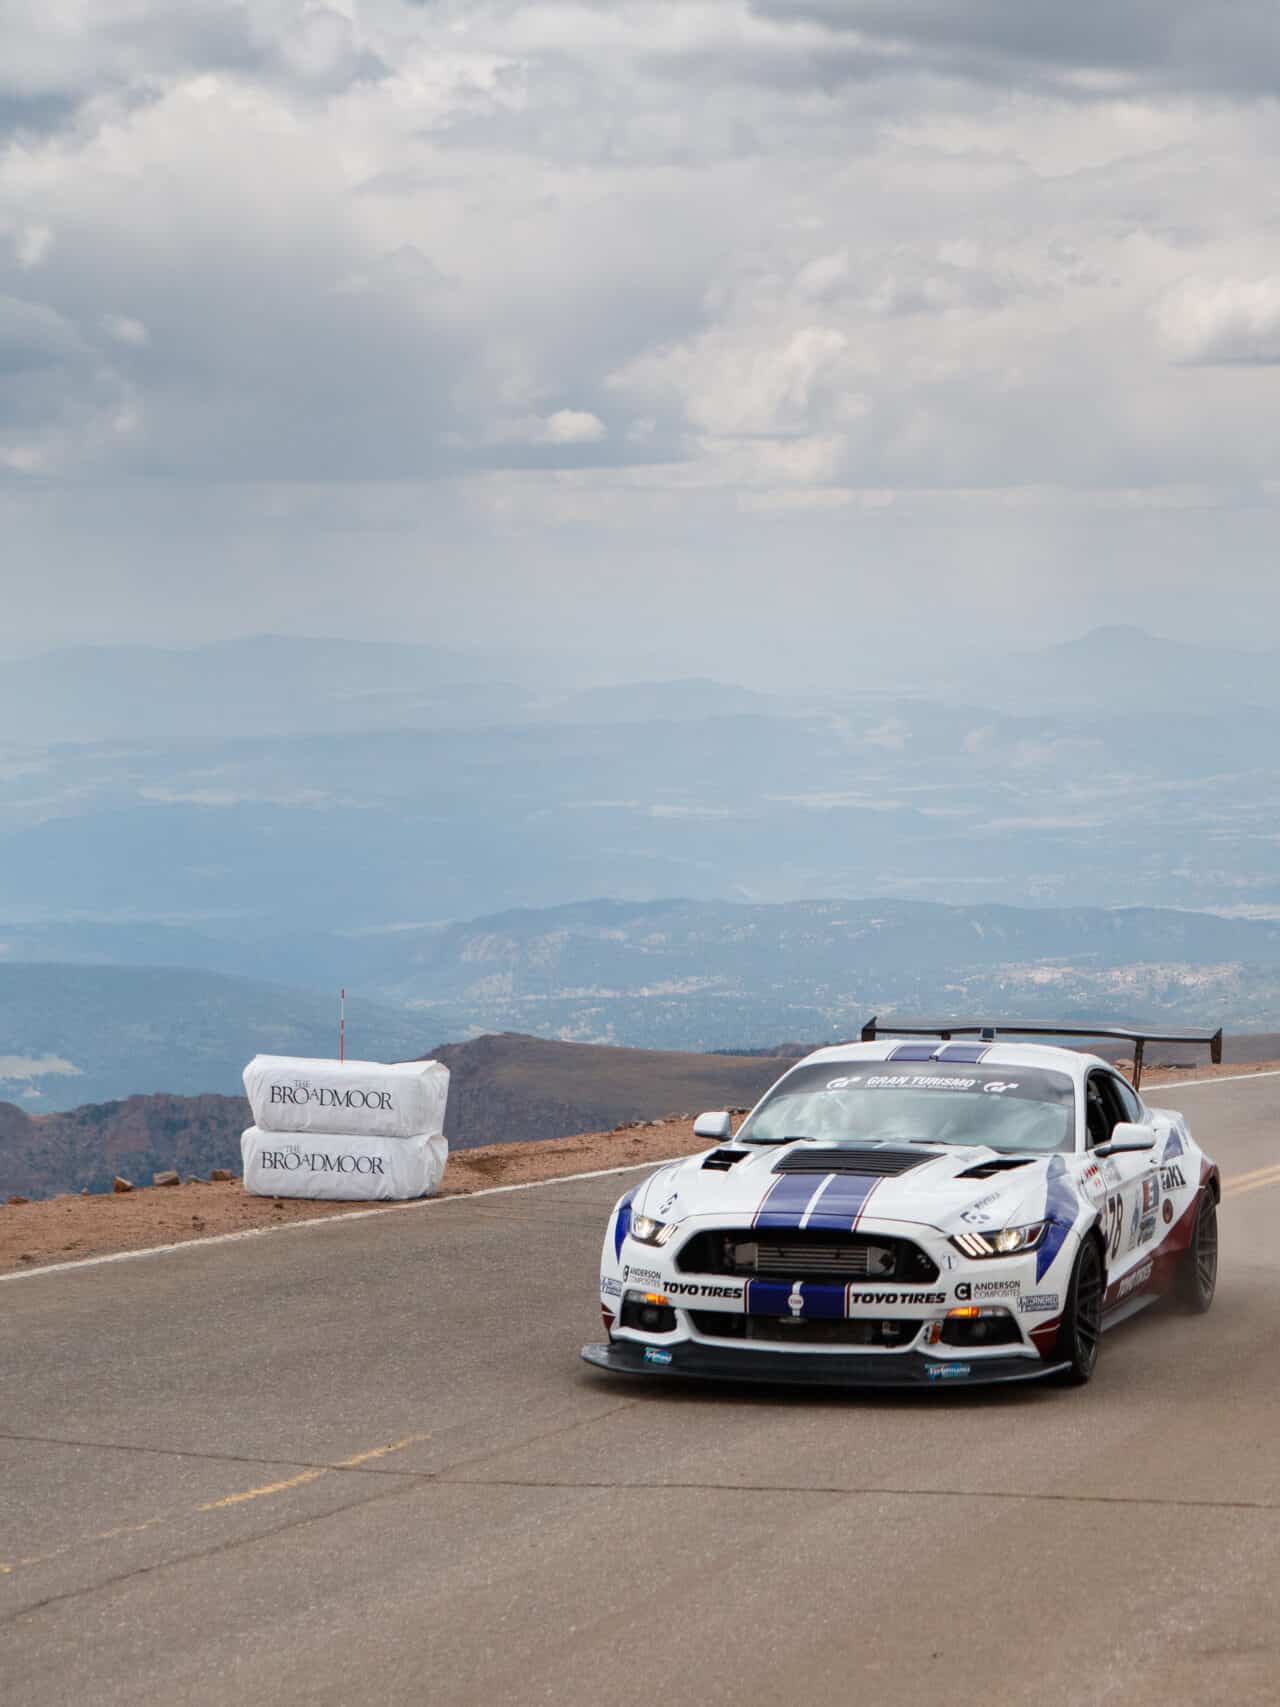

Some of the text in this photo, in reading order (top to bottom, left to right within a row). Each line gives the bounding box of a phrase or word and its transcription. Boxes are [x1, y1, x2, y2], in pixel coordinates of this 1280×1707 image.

[867, 1076, 910, 1086] GRAN
[911, 1076, 976, 1088] TURISMO
[270, 1086, 393, 1110] BROADMOOR
[262, 1151, 384, 1175] BROADMOOR
[630, 1267, 662, 1280] ANDERSON
[663, 1281, 743, 1299] TOYO TIRES
[974, 1280, 1021, 1291] ANDERSON
[852, 1292, 947, 1305] TOYO TIRES
